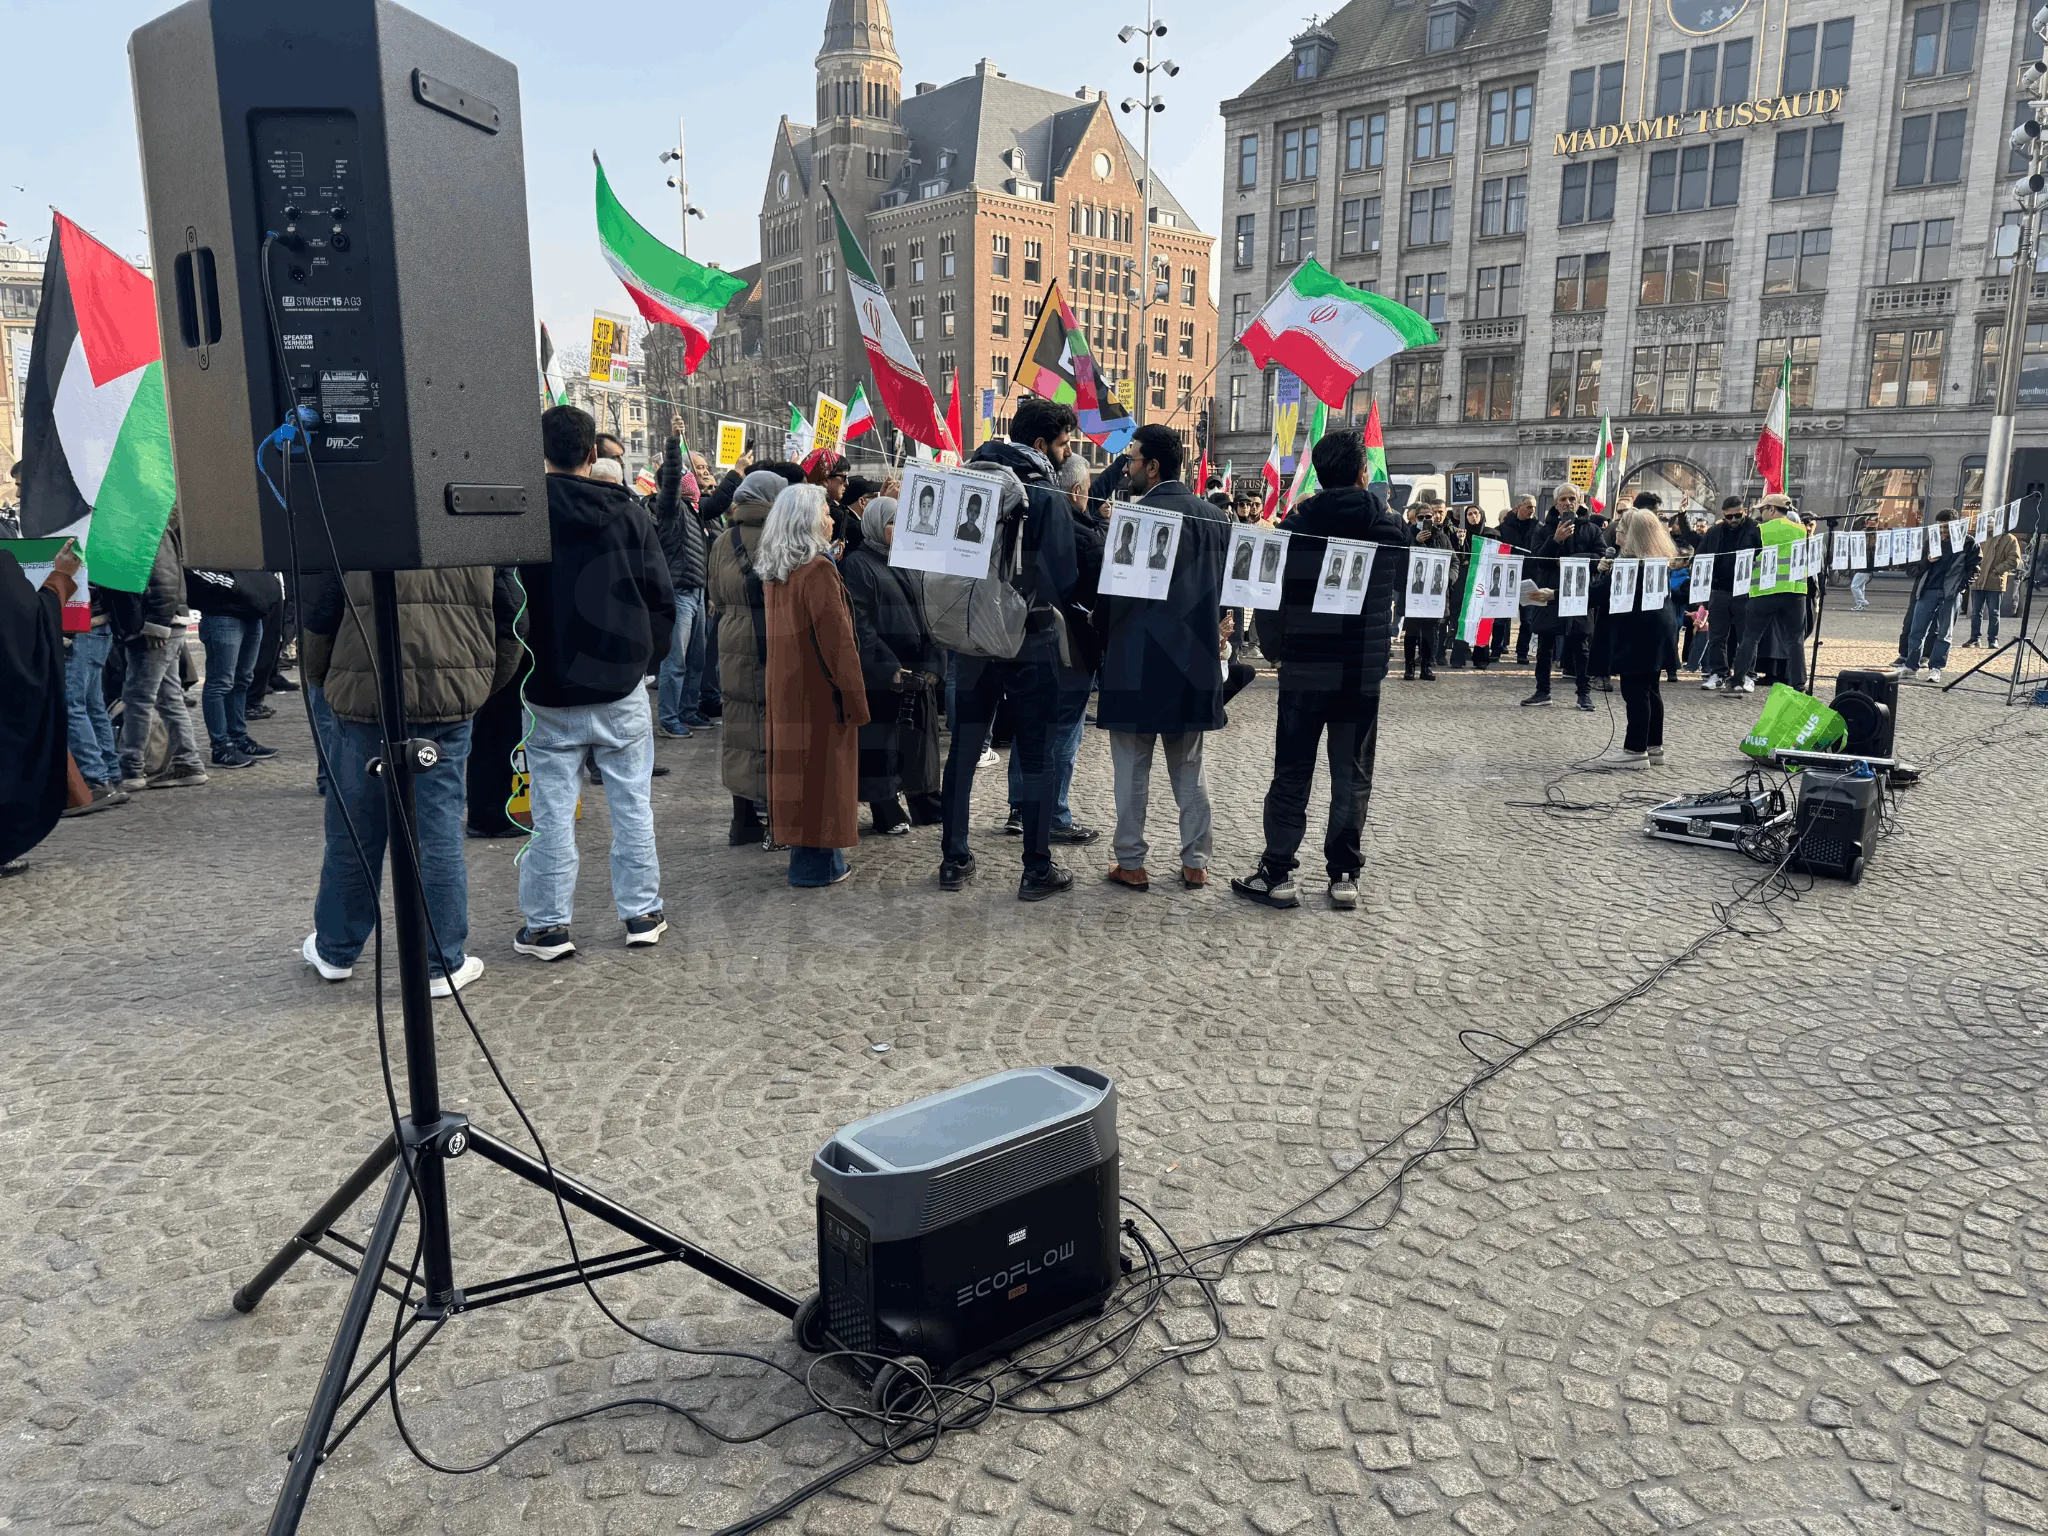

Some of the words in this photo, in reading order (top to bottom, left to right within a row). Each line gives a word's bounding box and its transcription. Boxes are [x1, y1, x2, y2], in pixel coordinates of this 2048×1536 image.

[1553, 114, 1685, 156] MADAME
[331, 297, 342, 306] 15
[343, 297, 350, 306] A
[350, 296, 362, 306] G3
[823, 404, 838, 422] STOP
[1517, 428, 1580, 440] PEEK
[1611, 418, 1845, 439] CLOPPENRG
[1796, 713, 1820, 745] PLUS
[1745, 735, 1768, 746] PLUS
[957, 1240, 1075, 1307] ECOFLOW
